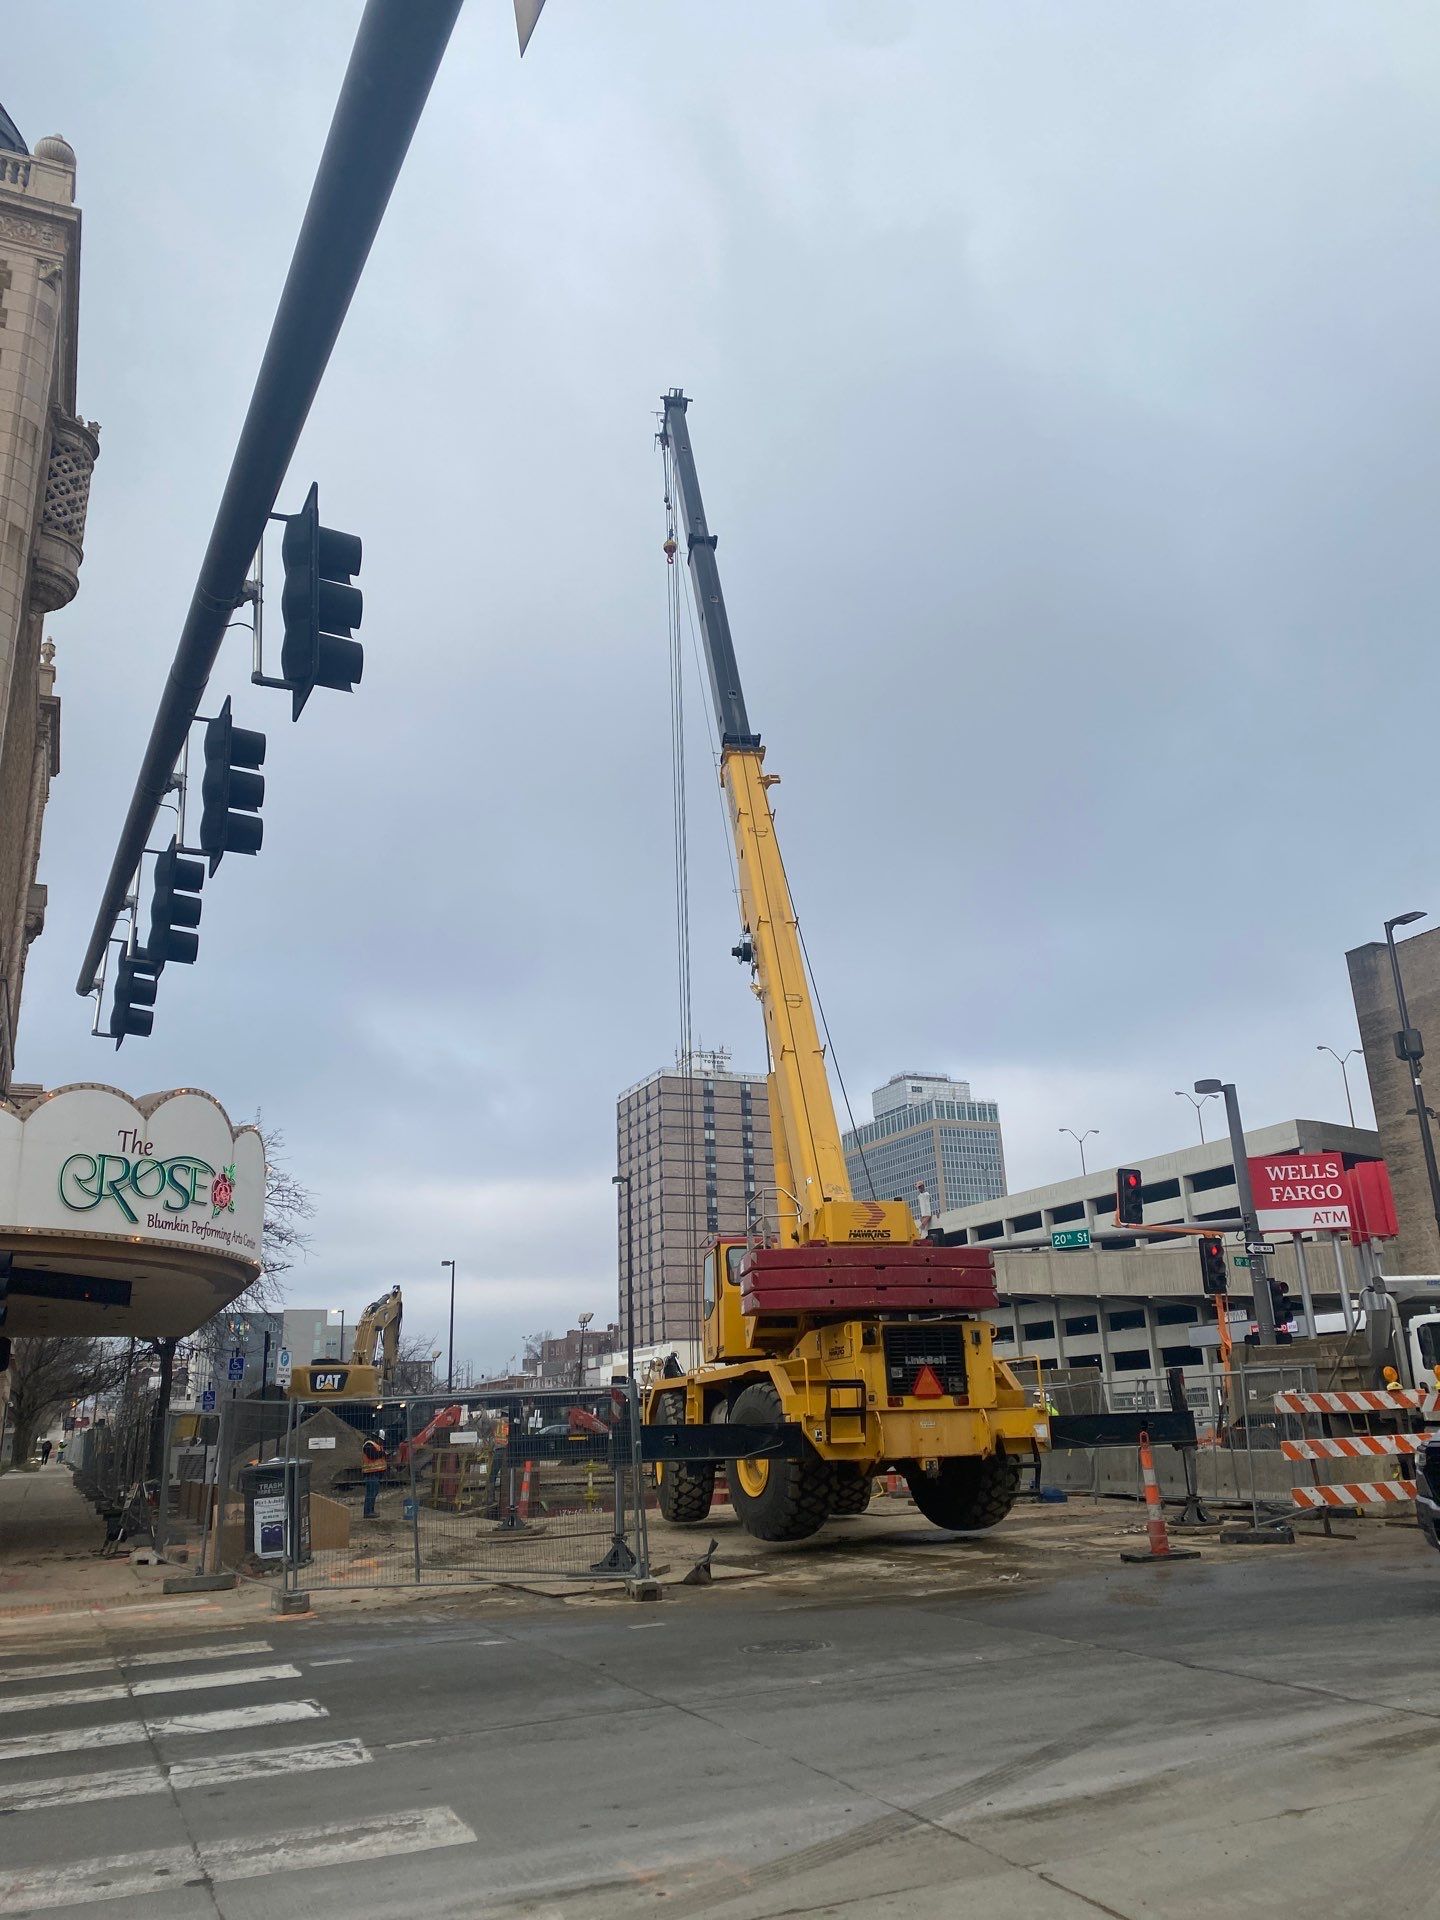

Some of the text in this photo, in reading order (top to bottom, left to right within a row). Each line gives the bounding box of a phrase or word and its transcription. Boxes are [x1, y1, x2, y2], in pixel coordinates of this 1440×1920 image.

[118, 1129, 153, 1156] The
[1265, 1162, 1339, 1181] WELLS
[59, 1153, 216, 1223] ROSE
[1270, 1183, 1343, 1202] FARGO
[1313, 1210, 1348, 1224] ATM
[147, 1213, 189, 1233] Blumkin
[191, 1220, 231, 1246] Performing
[231, 1230, 243, 1243] Arts
[849, 1229, 891, 1240] HAWKINS
[1054, 1232, 1087, 1245] 20th St
[905, 1356, 947, 1365] Link-Belt
[316, 1374, 341, 1390] CAT
[259, 1482, 283, 1490] TRASH
